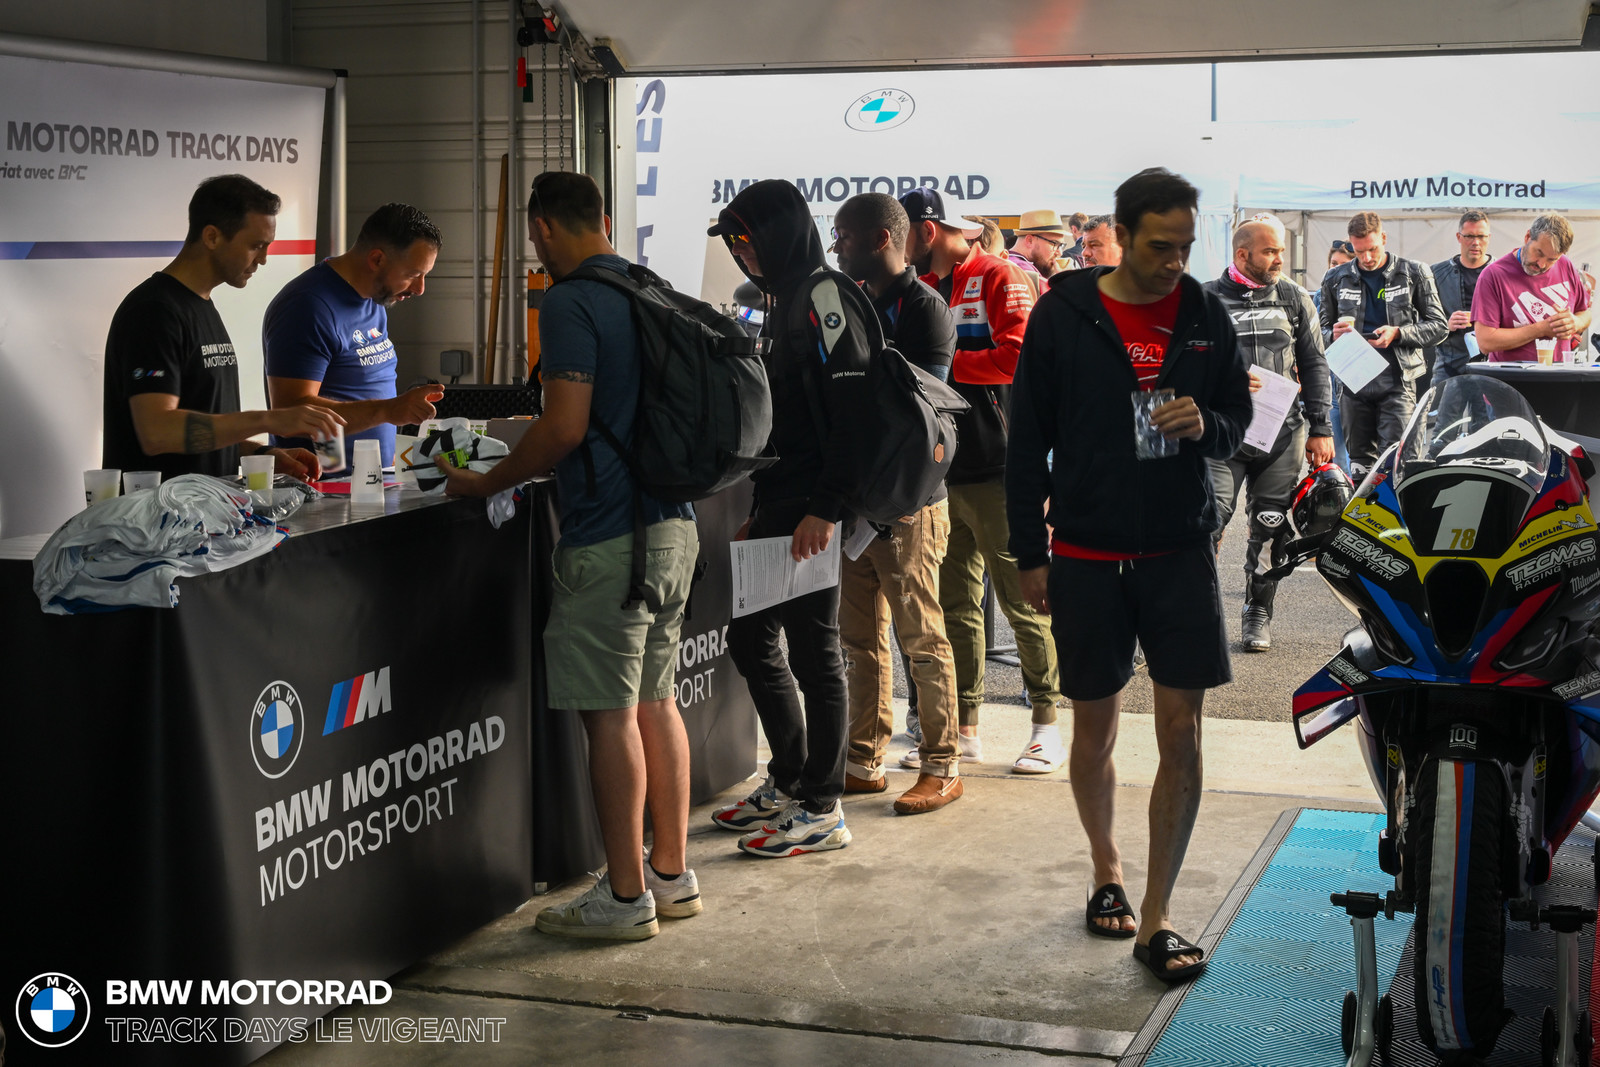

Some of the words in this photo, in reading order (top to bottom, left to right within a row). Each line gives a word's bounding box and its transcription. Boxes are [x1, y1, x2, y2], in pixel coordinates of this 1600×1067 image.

[7, 121, 159, 157] MOTORRAD
[167, 130, 241, 161] TRACK
[247, 135, 298, 164] DAYS
[24, 167, 55, 179] avec
[712, 178, 758, 203] BM
[1350, 178, 1418, 199] BMW
[1426, 176, 1546, 199] Motorrad
[201, 344, 219, 356] BMW
[1432, 479, 1492, 550] 1
[1335, 527, 1410, 577] TECMAS
[1449, 528, 1476, 550] 78
[1518, 524, 1563, 548] MICHELIN
[1331, 540, 1363, 563] RACING
[1366, 562, 1394, 581] TEAM
[1505, 537, 1597, 585] TECMAS
[1515, 567, 1561, 592] RACING
[1566, 555, 1597, 569] TEAM
[256, 686, 296, 719] BMW
[254, 779, 333, 852] BMW
[342, 715, 507, 811] MOTORRAD
[259, 777, 459, 907] MOTORSPORT
